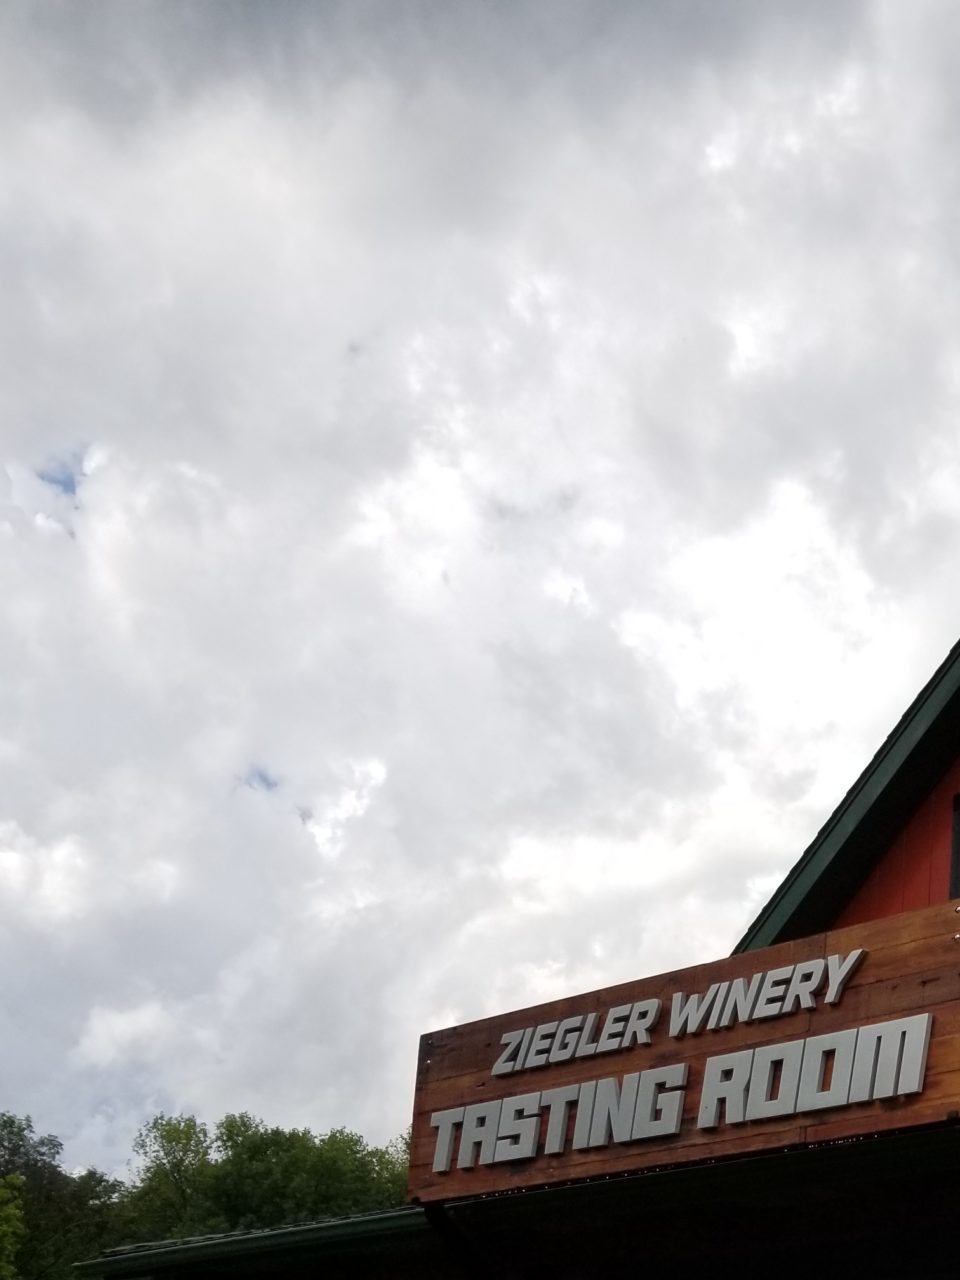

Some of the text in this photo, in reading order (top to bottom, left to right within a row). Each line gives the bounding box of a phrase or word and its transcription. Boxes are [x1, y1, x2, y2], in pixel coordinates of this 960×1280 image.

[491, 948, 868, 1076] ZIEGLER WINERY
[430, 1013, 932, 1173] TASTING ROOM
